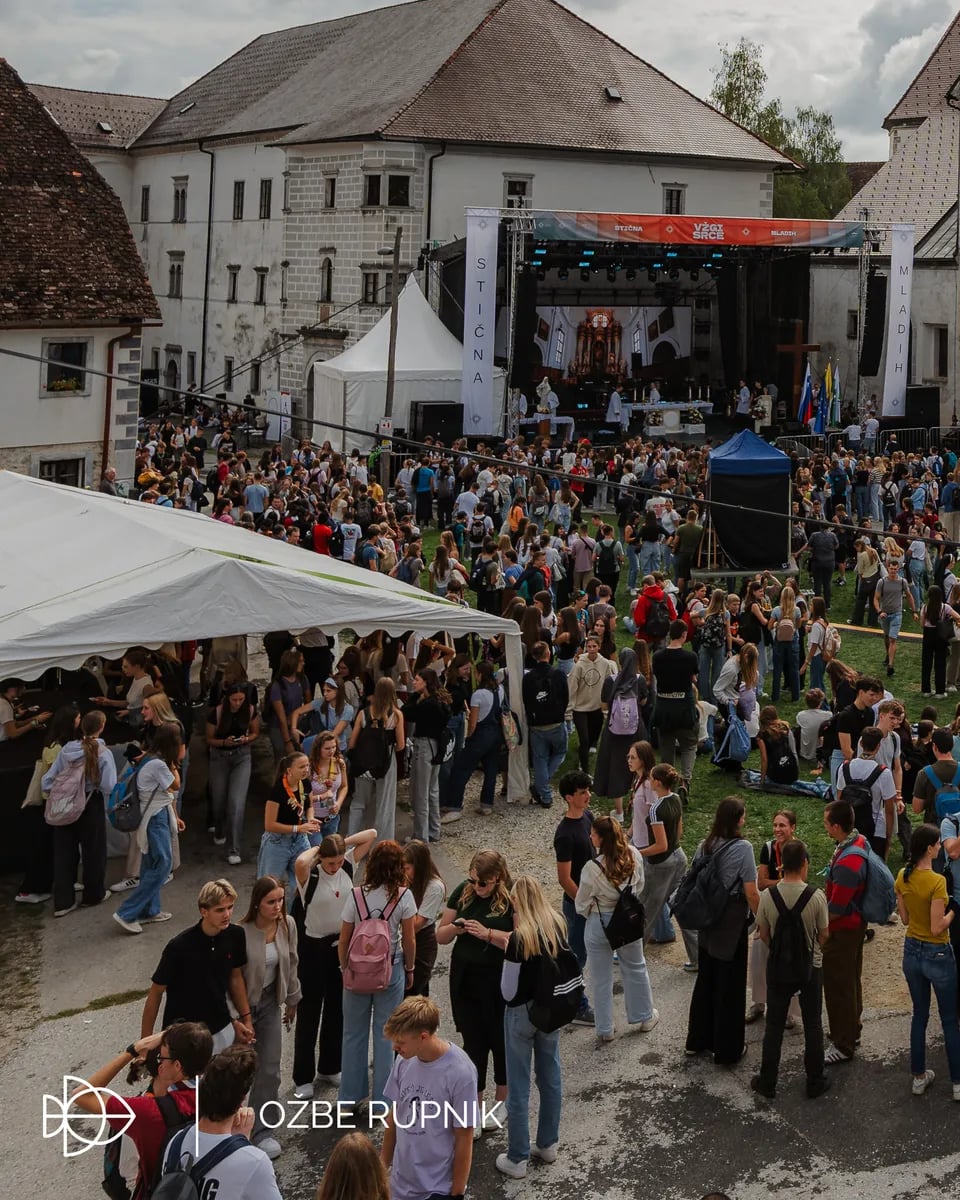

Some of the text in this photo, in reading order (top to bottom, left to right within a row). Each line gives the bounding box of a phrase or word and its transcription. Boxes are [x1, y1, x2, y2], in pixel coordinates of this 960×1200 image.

[614, 224, 643, 232] STIČNA
[694, 222, 724, 232] VŽGI
[692, 231, 725, 240] SRCE
[473, 257, 487, 384] STIČNA
[894, 265, 909, 373] MLADIH
